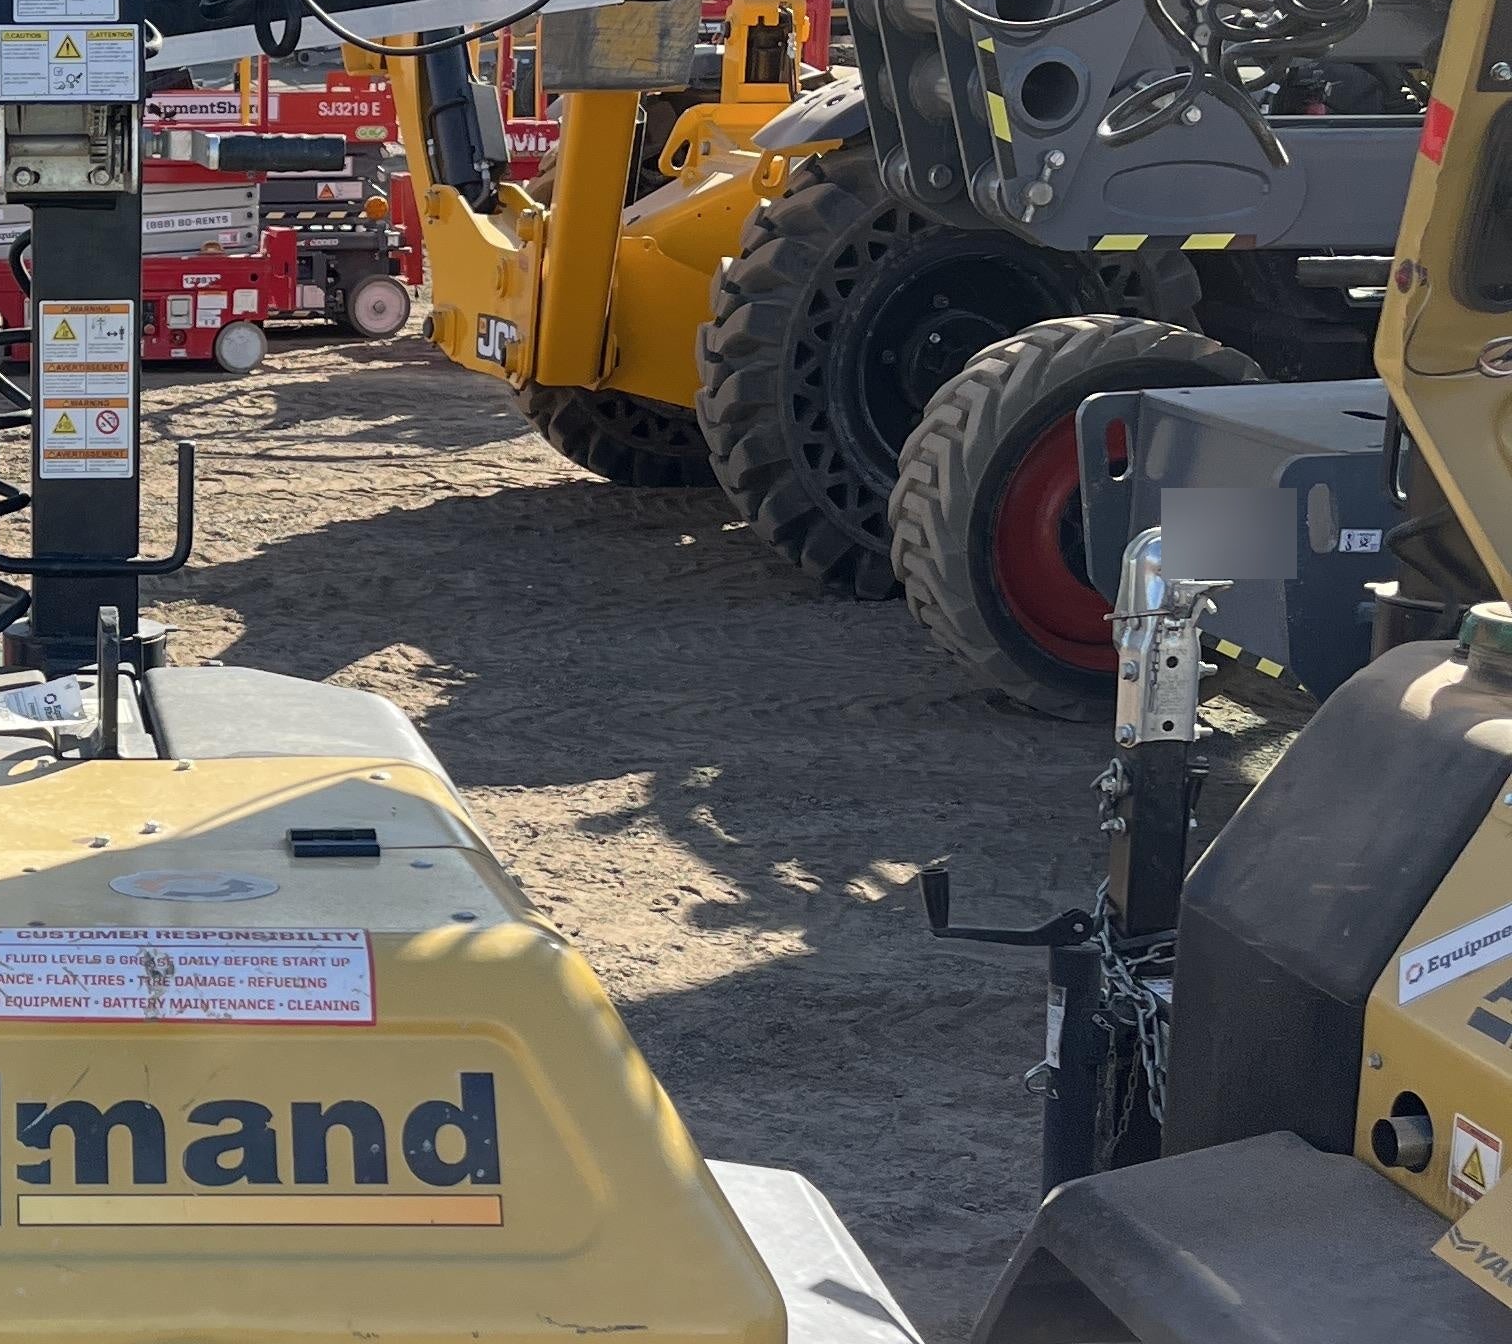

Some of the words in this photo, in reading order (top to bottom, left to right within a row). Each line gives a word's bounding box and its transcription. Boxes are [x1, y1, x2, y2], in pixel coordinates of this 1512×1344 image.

[10, 31, 42, 40] CAUTION
[94, 30, 134, 39] ATTENTION
[317, 101, 370, 117] SJ3219
[371, 101, 381, 117] E
[56, 363, 124, 372] AVERTISSEMENT
[70, 399, 110, 407] WARNING
[56, 450, 124, 458] AVERTISSEMENT
[16, 929, 149, 941] CUSTOMER
[155, 930, 360, 943] RESPONSIBILITY
[5, 954, 48, 964] FLUID
[51, 954, 102, 965] LEVELS
[106, 955, 115, 965] &
[178, 956, 219, 967] DAILY
[224, 956, 278, 967] BEFORE
[283, 957, 326, 967] START
[331, 957, 350, 967] UP
[45, 974, 77, 985] FLAT
[81, 975, 126, 986] TIRES
[137, 976, 170, 987] TIRE
[174, 976, 236, 988] DAMAGE
[247, 976, 328, 989] REFUELING
[5, 996, 90, 1008] EQUIPMENT
[102, 997, 166, 1009] BATTERY
[169, 998, 276, 1011] MAINTENANCE
[287, 999, 361, 1012] CLEANING
